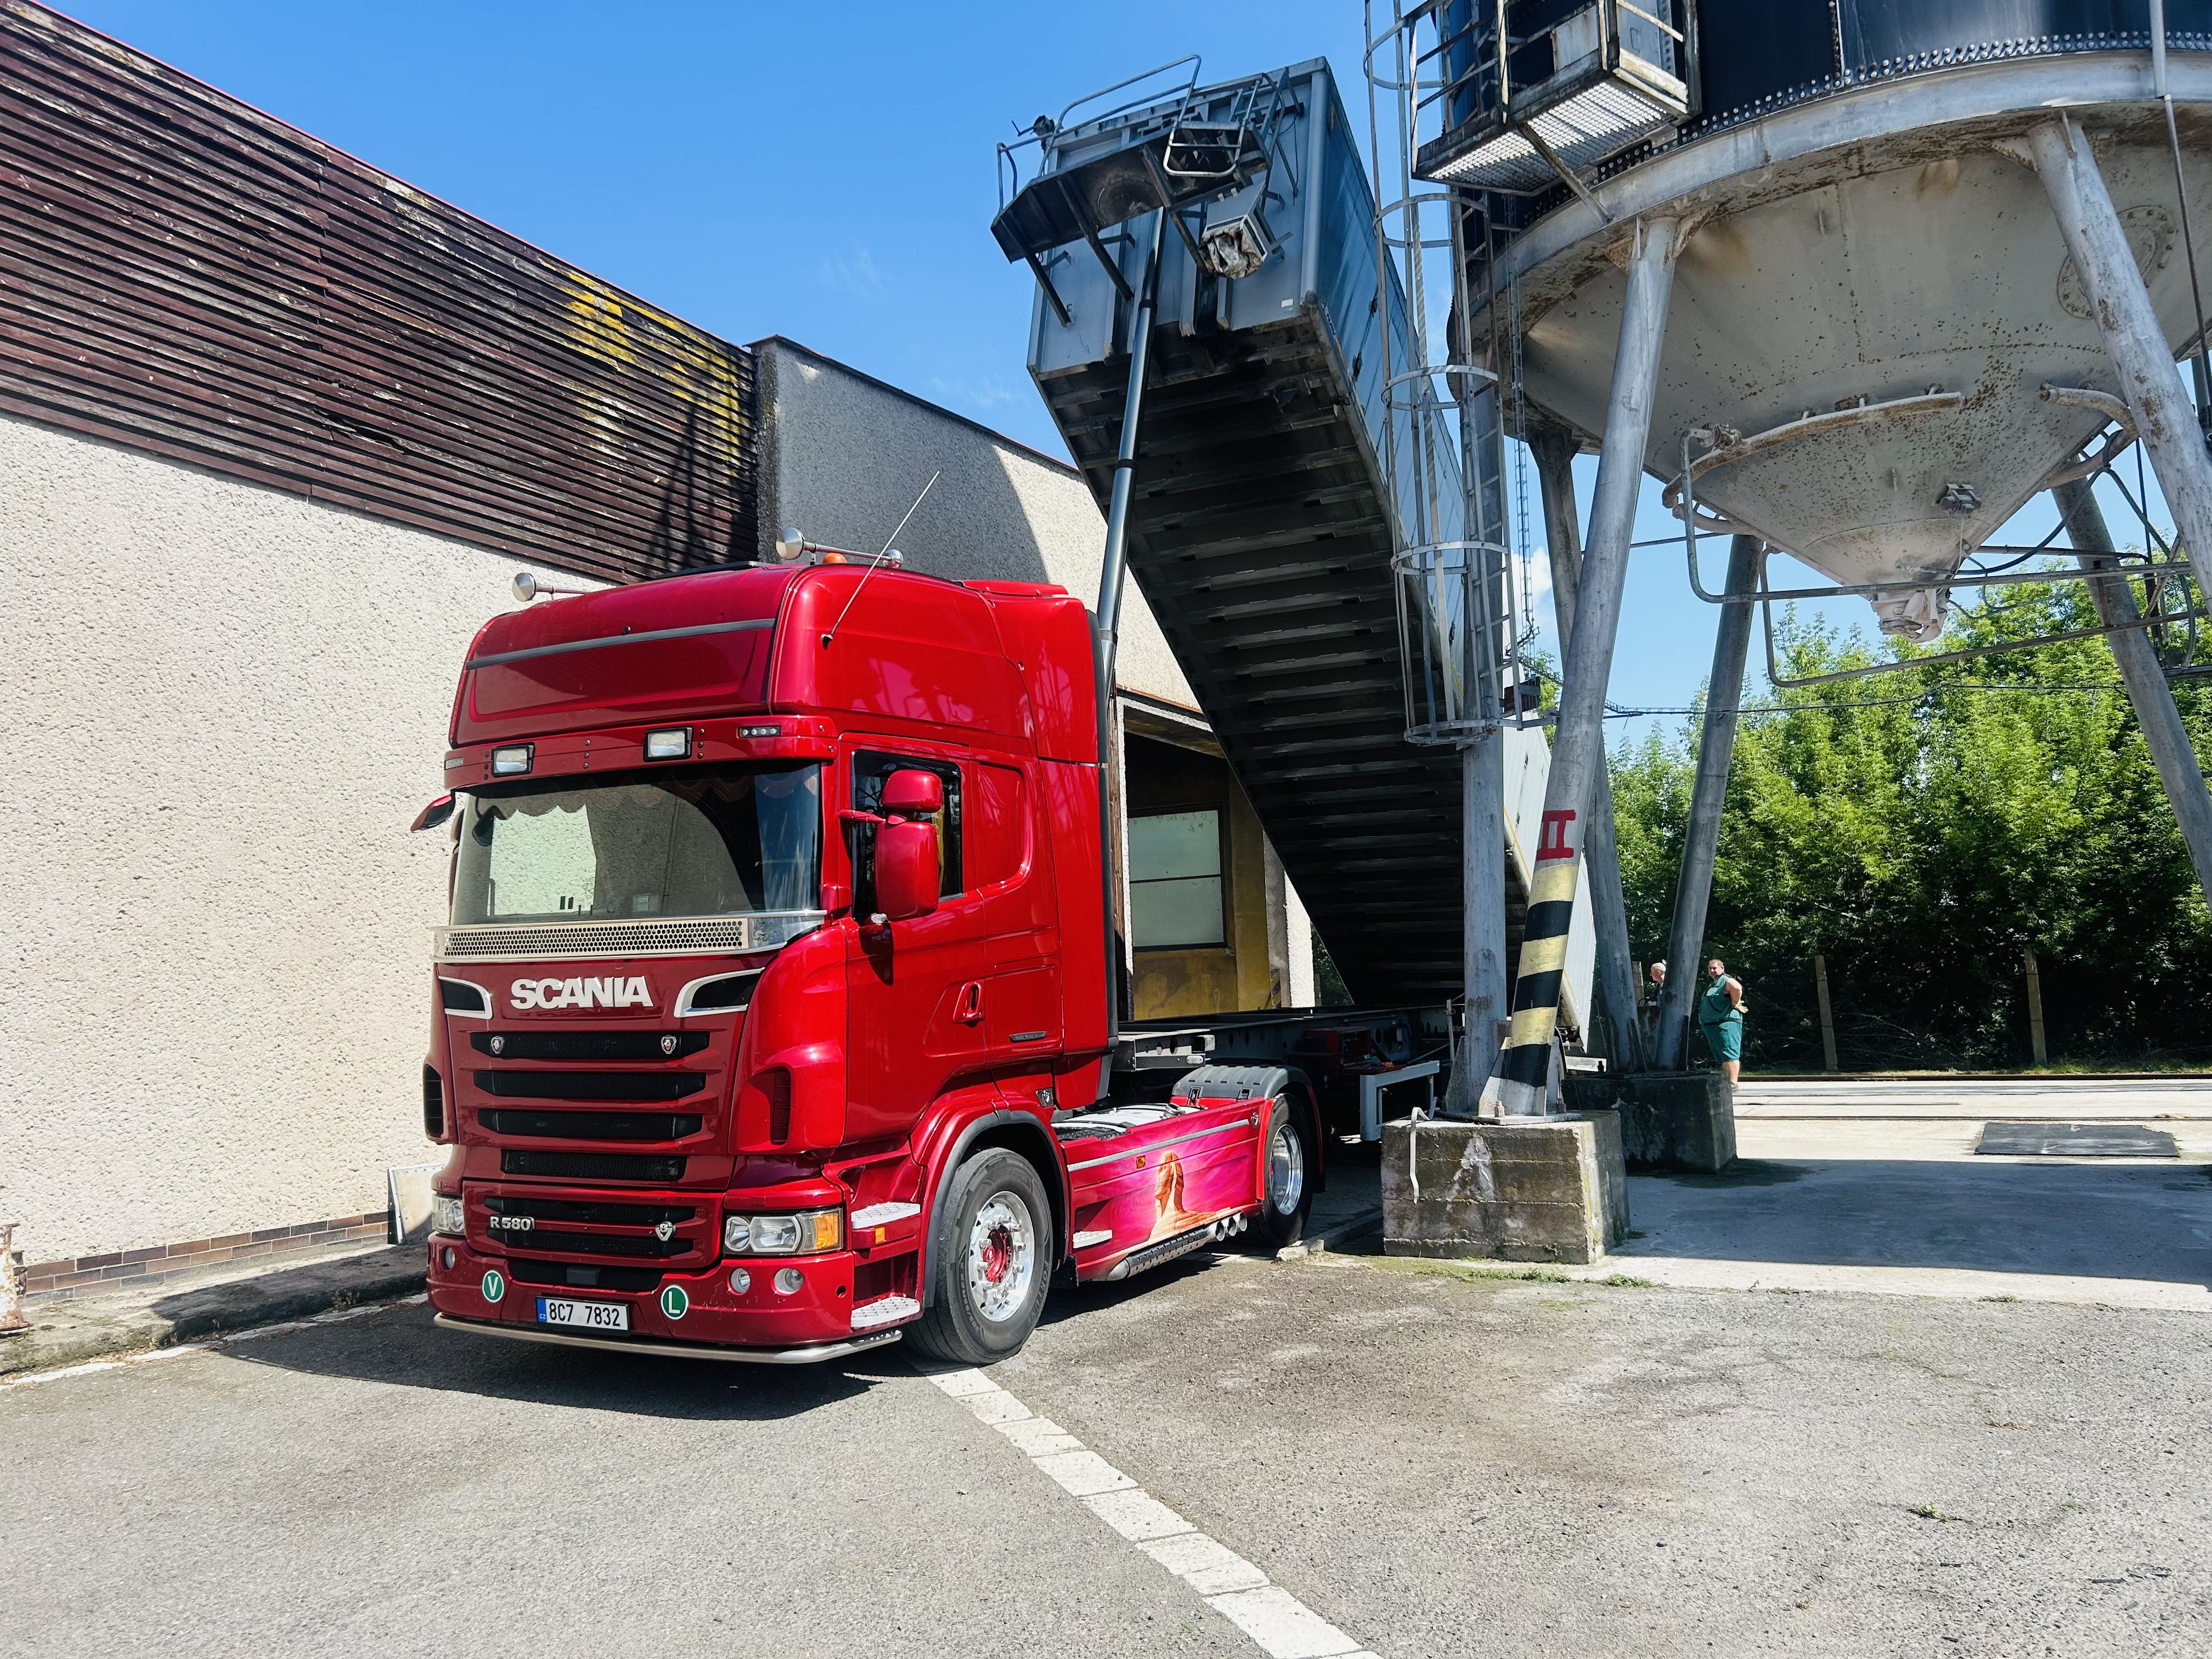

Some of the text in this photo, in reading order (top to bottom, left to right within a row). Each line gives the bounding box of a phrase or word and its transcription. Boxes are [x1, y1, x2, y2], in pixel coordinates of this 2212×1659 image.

[510, 977, 654, 1009] SCANIA
[490, 1216, 531, 1231] R 580
[488, 1276, 499, 1297] V
[549, 1302, 573, 1322] 8C7
[585, 1306, 620, 1326] 7832
[668, 1291, 680, 1314] L
